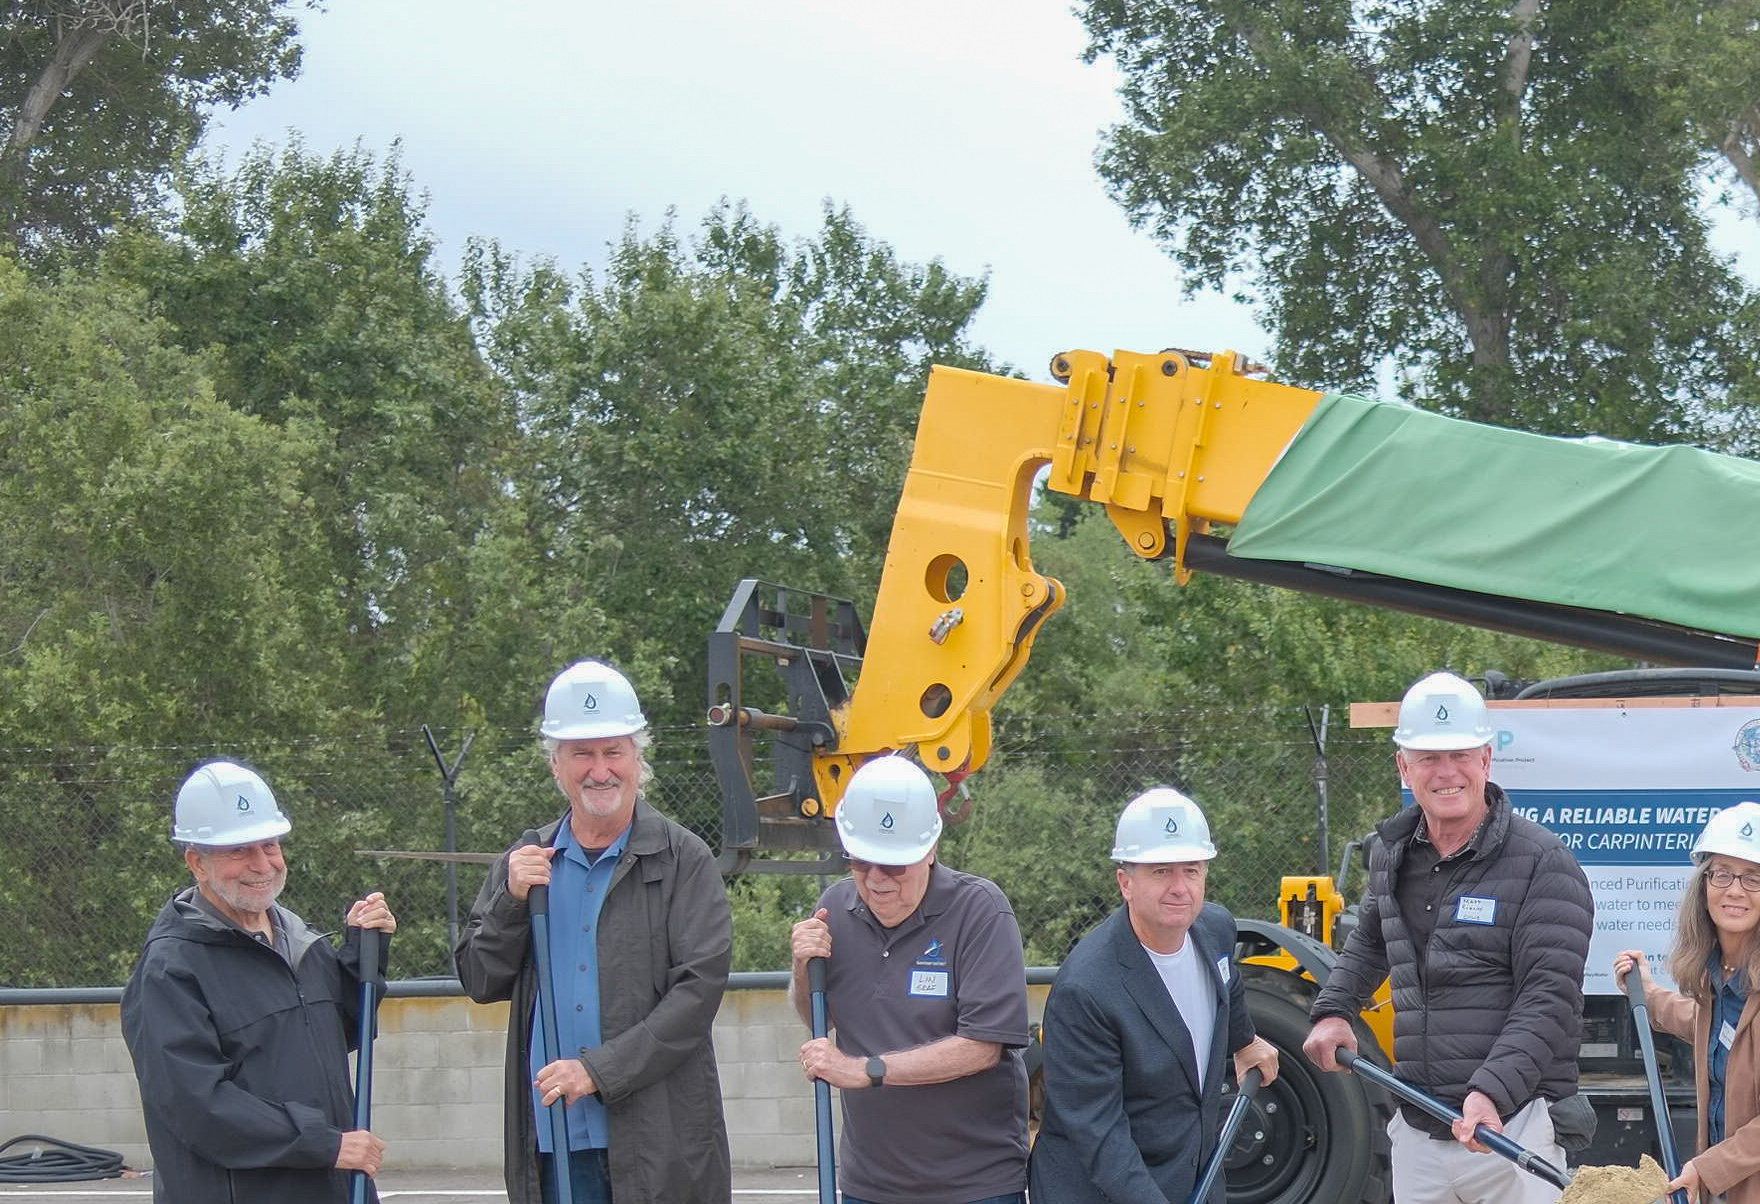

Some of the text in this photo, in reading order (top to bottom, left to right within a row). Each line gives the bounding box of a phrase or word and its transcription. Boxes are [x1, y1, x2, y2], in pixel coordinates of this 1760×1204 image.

[1541, 807, 1555, 824] A
[1559, 807, 1652, 824] RELIABLE
[1554, 833, 1584, 849] OR
[1626, 877, 1688, 891] Purificati
[1596, 899, 1633, 911] water
[1637, 899, 1650, 911] to
[1596, 919, 1633, 931] water
